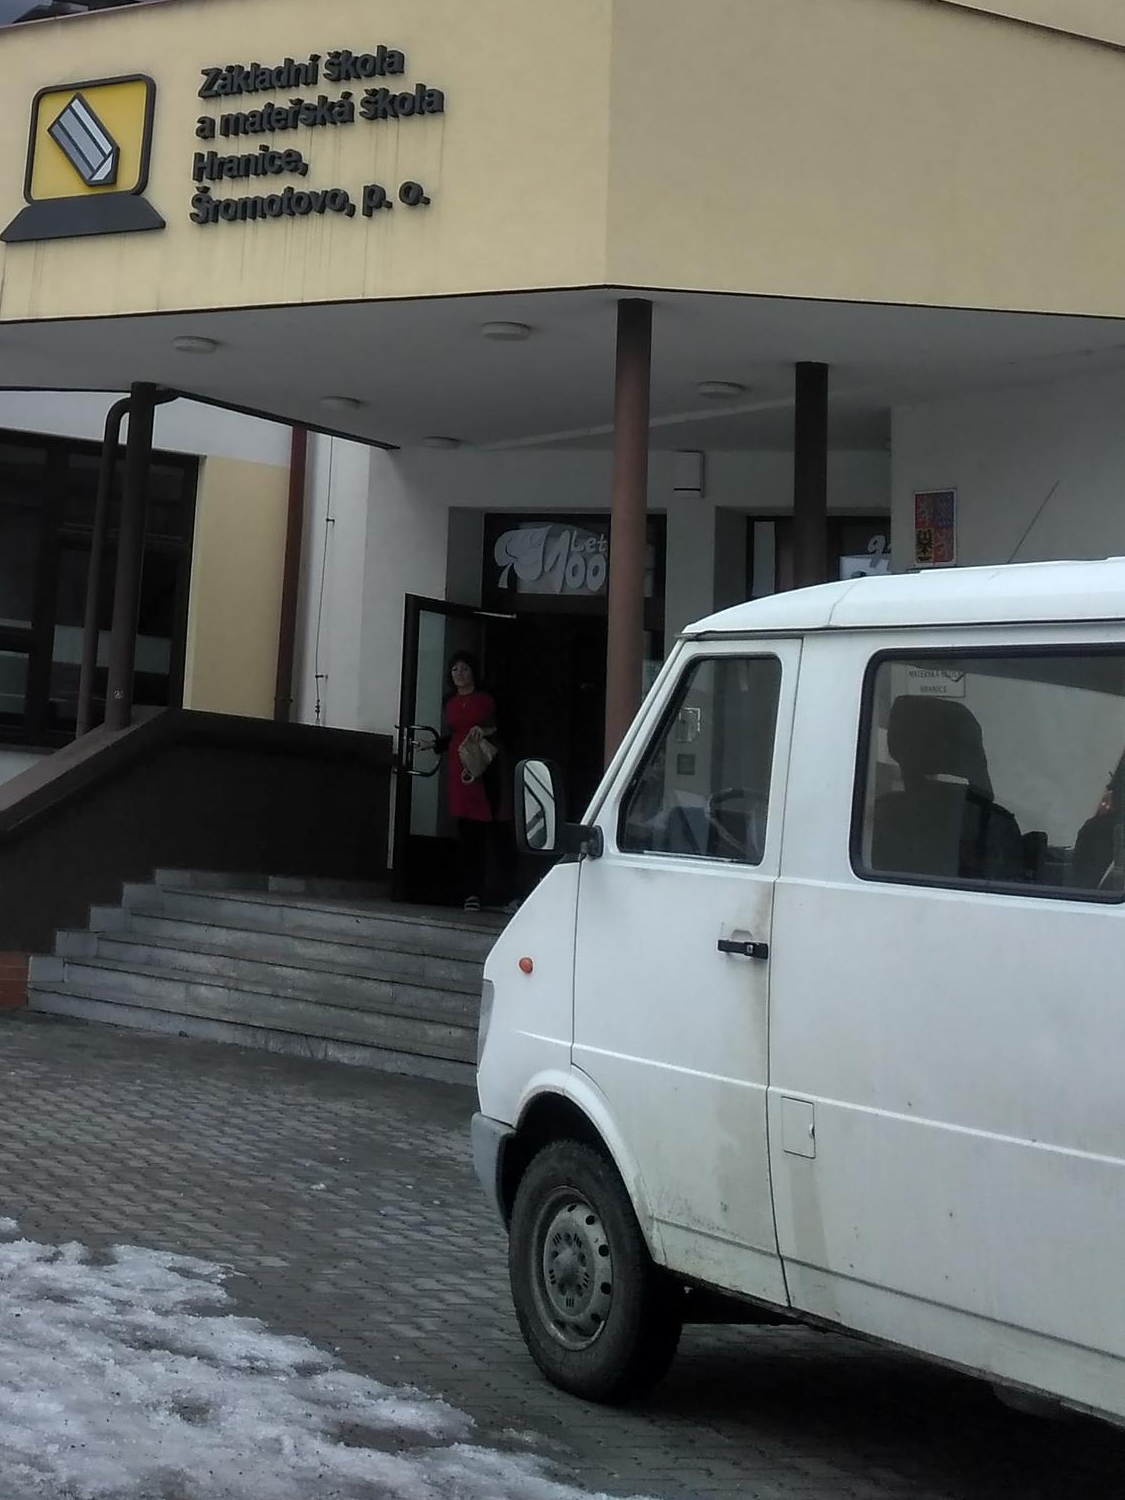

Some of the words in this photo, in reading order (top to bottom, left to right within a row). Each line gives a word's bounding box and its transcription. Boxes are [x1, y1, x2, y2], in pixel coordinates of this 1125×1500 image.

[198, 54, 321, 98] Základní
[324, 45, 405, 81] škola
[195, 115, 216, 139] a
[219, 91, 355, 137] mateřská
[360, 83, 445, 120] škola
[192, 144, 308, 182] Hranice,
[189, 186, 356, 224] Šromotovo,
[571, 530, 607, 553] Let
